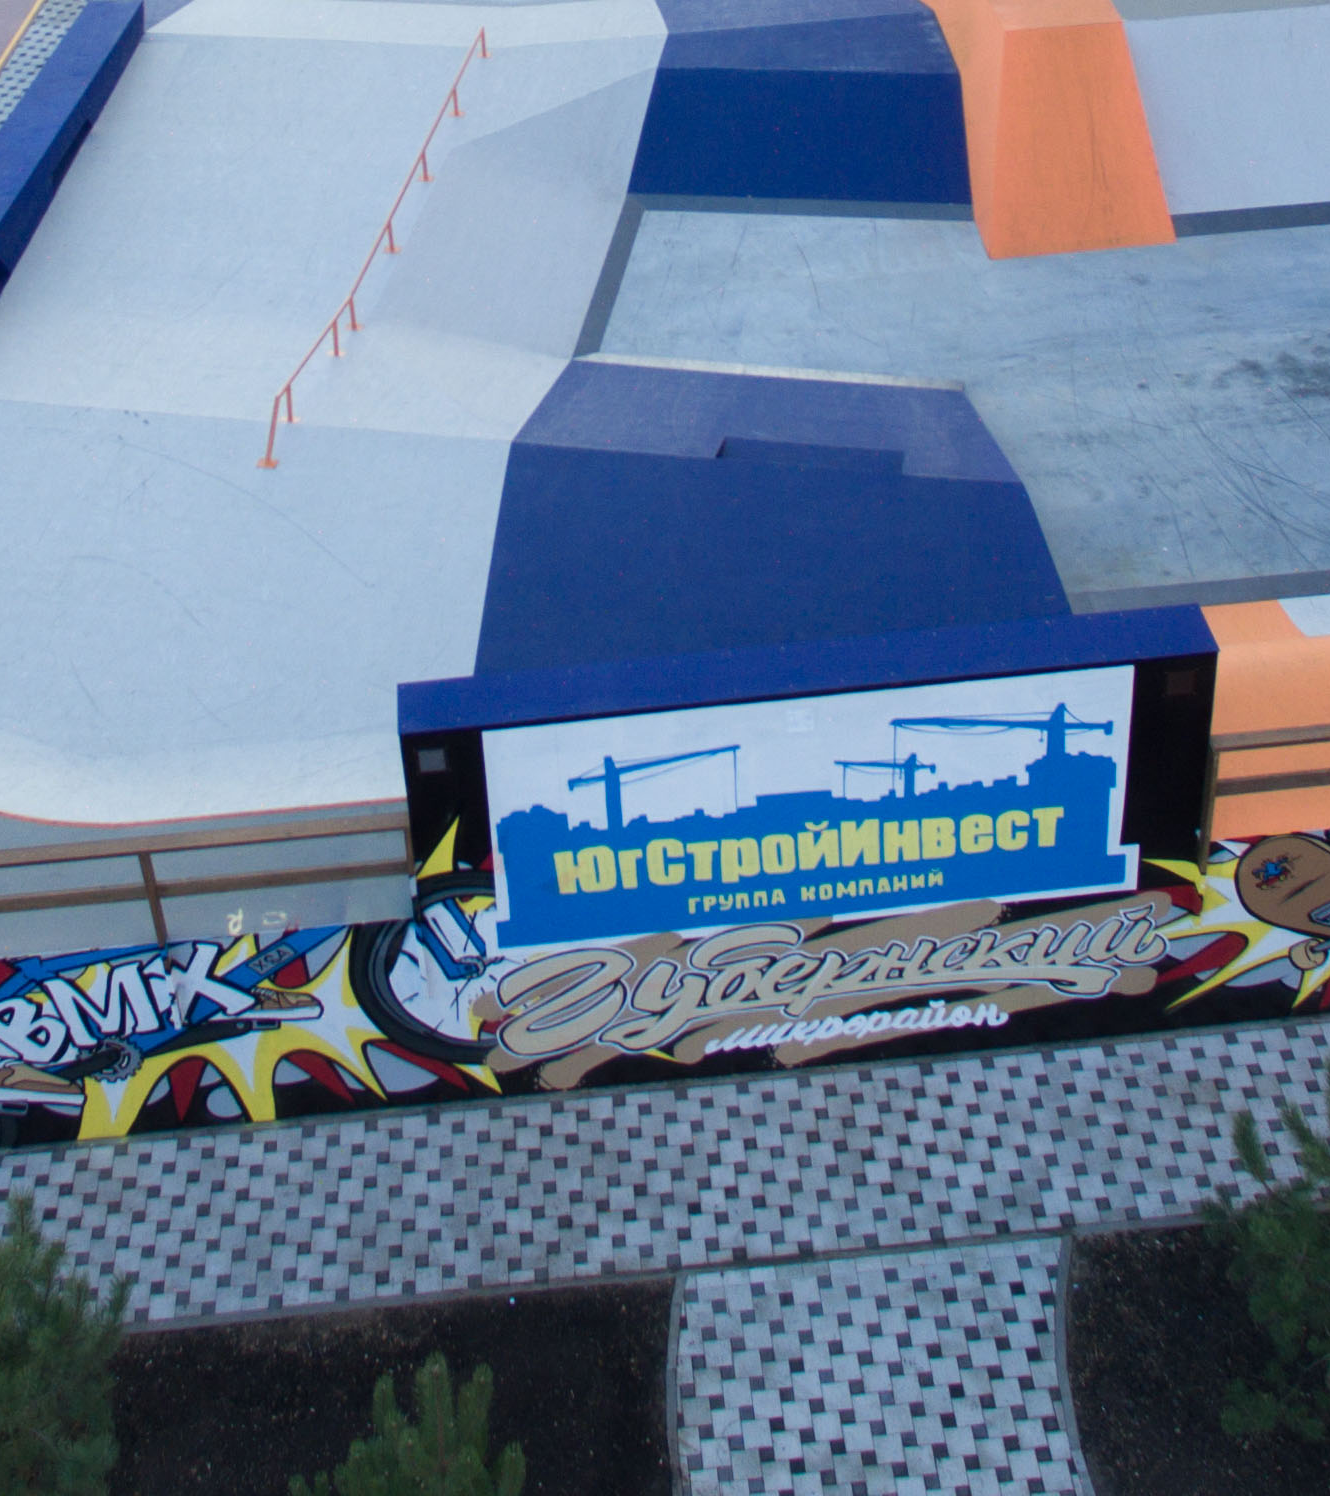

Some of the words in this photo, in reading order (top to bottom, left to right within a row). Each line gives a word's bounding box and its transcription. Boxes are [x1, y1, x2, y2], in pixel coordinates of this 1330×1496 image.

[687, 888, 788, 915] ГРУППА
[800, 868, 946, 902] КОМПАНИЙ
[704, 1001, 1010, 1056] микрорайон
